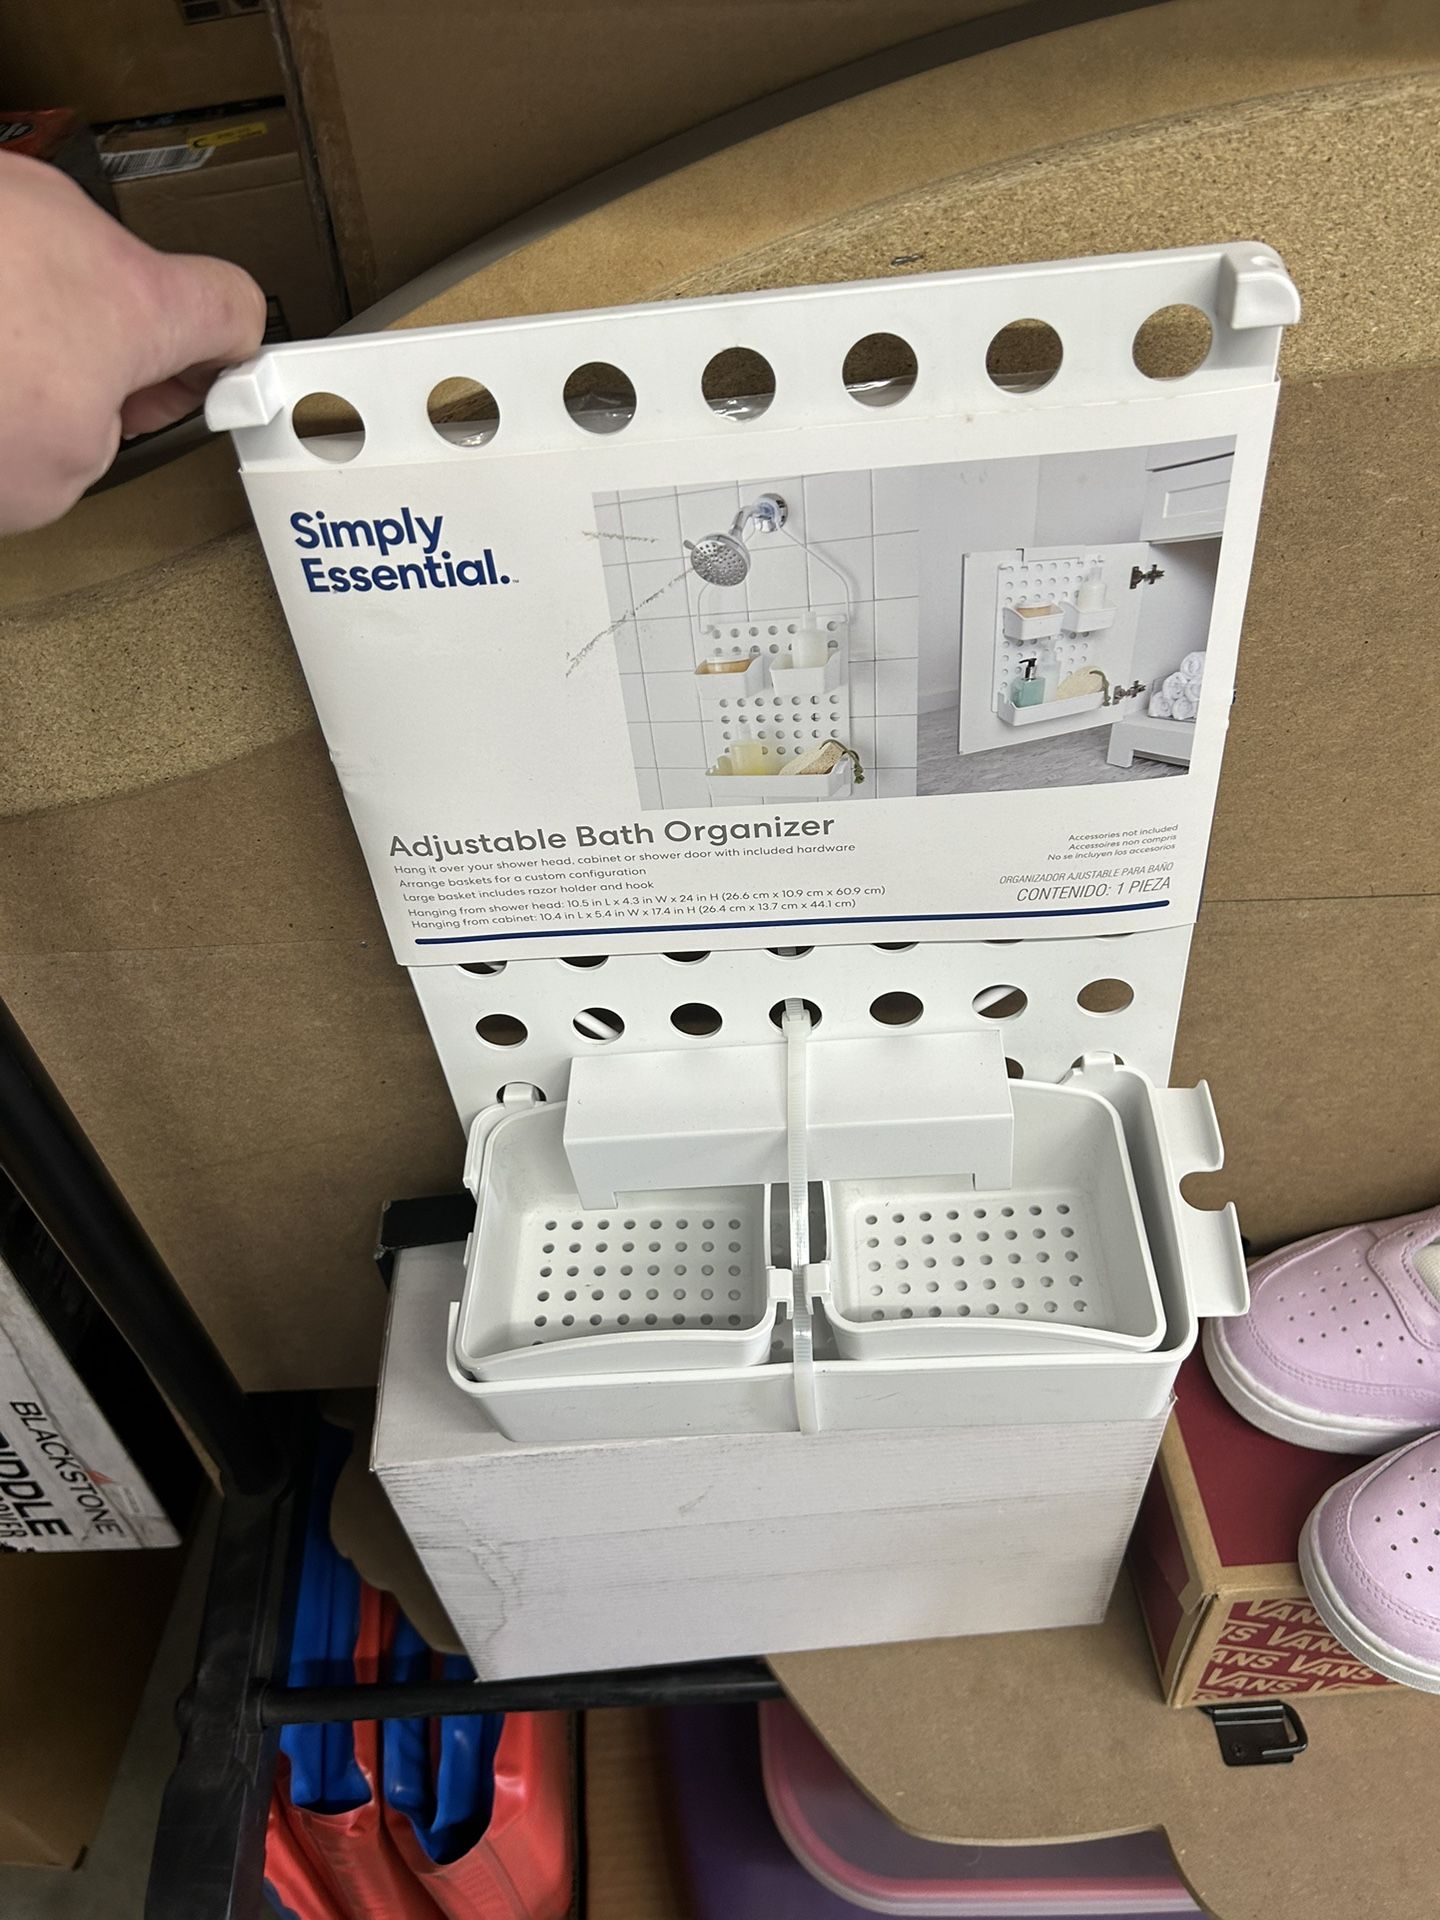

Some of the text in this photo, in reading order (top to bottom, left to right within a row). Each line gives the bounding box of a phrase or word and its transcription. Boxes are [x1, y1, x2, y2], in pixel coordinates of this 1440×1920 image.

[290, 507, 443, 556] Simply
[389, 816, 835, 862] Adjustable Bath Organizer
[1068, 832, 1120, 842] Accessories
[1139, 824, 1179, 835] included
[1068, 841, 1120, 851] Accessoires
[1141, 835, 1177, 844] compris
[393, 865, 427, 876] Hang
[428, 865, 437, 873] it
[439, 865, 464, 873] over
[467, 864, 493, 873] your
[496, 860, 538, 869] shower
[541, 857, 575, 866] head,
[577, 855, 621, 864] cabinet
[639, 852, 681, 861] shower
[684, 850, 711, 859] door
[714, 848, 740, 857] with
[743, 846, 793, 856] included
[797, 844, 856, 853] hardware
[1075, 851, 1113, 859] incluyen
[1129, 844, 1175, 855] accesorios
[399, 879, 445, 890] Arrange
[447, 877, 492, 887] baskets
[494, 875, 511, 883] for
[524, 873, 566, 881] custom
[569, 868, 646, 879] configuration
[999, 861, 1174, 885] ORGANIZADOR AJUSTABLE PARA BAÑO
[403, 881, 654, 904] Large basket includes razor holder and hook
[407, 909, 457, 918] Hanging
[459, 906, 486, 915] from
[489, 901, 529, 913] shower
[531, 901, 565, 910] head:
[567, 899, 589, 908] 10.5
[604, 898, 611, 906] L
[622, 896, 640, 905] 4.3
[642, 896, 653, 904] in
[655, 895, 667, 903] W
[679, 894, 693, 903] 24
[710, 893, 719, 901] H
[721, 892, 750, 902] (26.6
[782, 889, 804, 898] 10.9
[836, 887, 861, 896] 60.9
[864, 885, 886, 895] cm)
[1017, 876, 1170, 902] CONTENIDO: 1 PIEZA
[411, 920, 461, 930] Hanging
[462, 918, 489, 926] from
[492, 915, 537, 924] cabinet:
[539, 912, 562, 921] 10.4
[564, 910, 575, 920] in
[577, 911, 584, 919] L
[595, 910, 612, 918] 5.4
[614, 909, 625, 917] in
[627, 908, 639, 916] W
[652, 907, 671, 915] 17.4
[674, 905, 684, 914] in
[687, 906, 696, 914] H
[698, 905, 726, 915] (26.4
[758, 902, 778, 911] 13.7
[810, 900, 832, 908] 44.1
[834, 899, 856, 908] cm)
[0, 1430, 73, 1537] IDDLE
[9, 1401, 126, 1538] BLACKSTONE
[0, 1496, 28, 1539] OVER
[1212, 1645, 1374, 1681] ANS VANS
[1205, 1668, 1308, 1692] VANS
